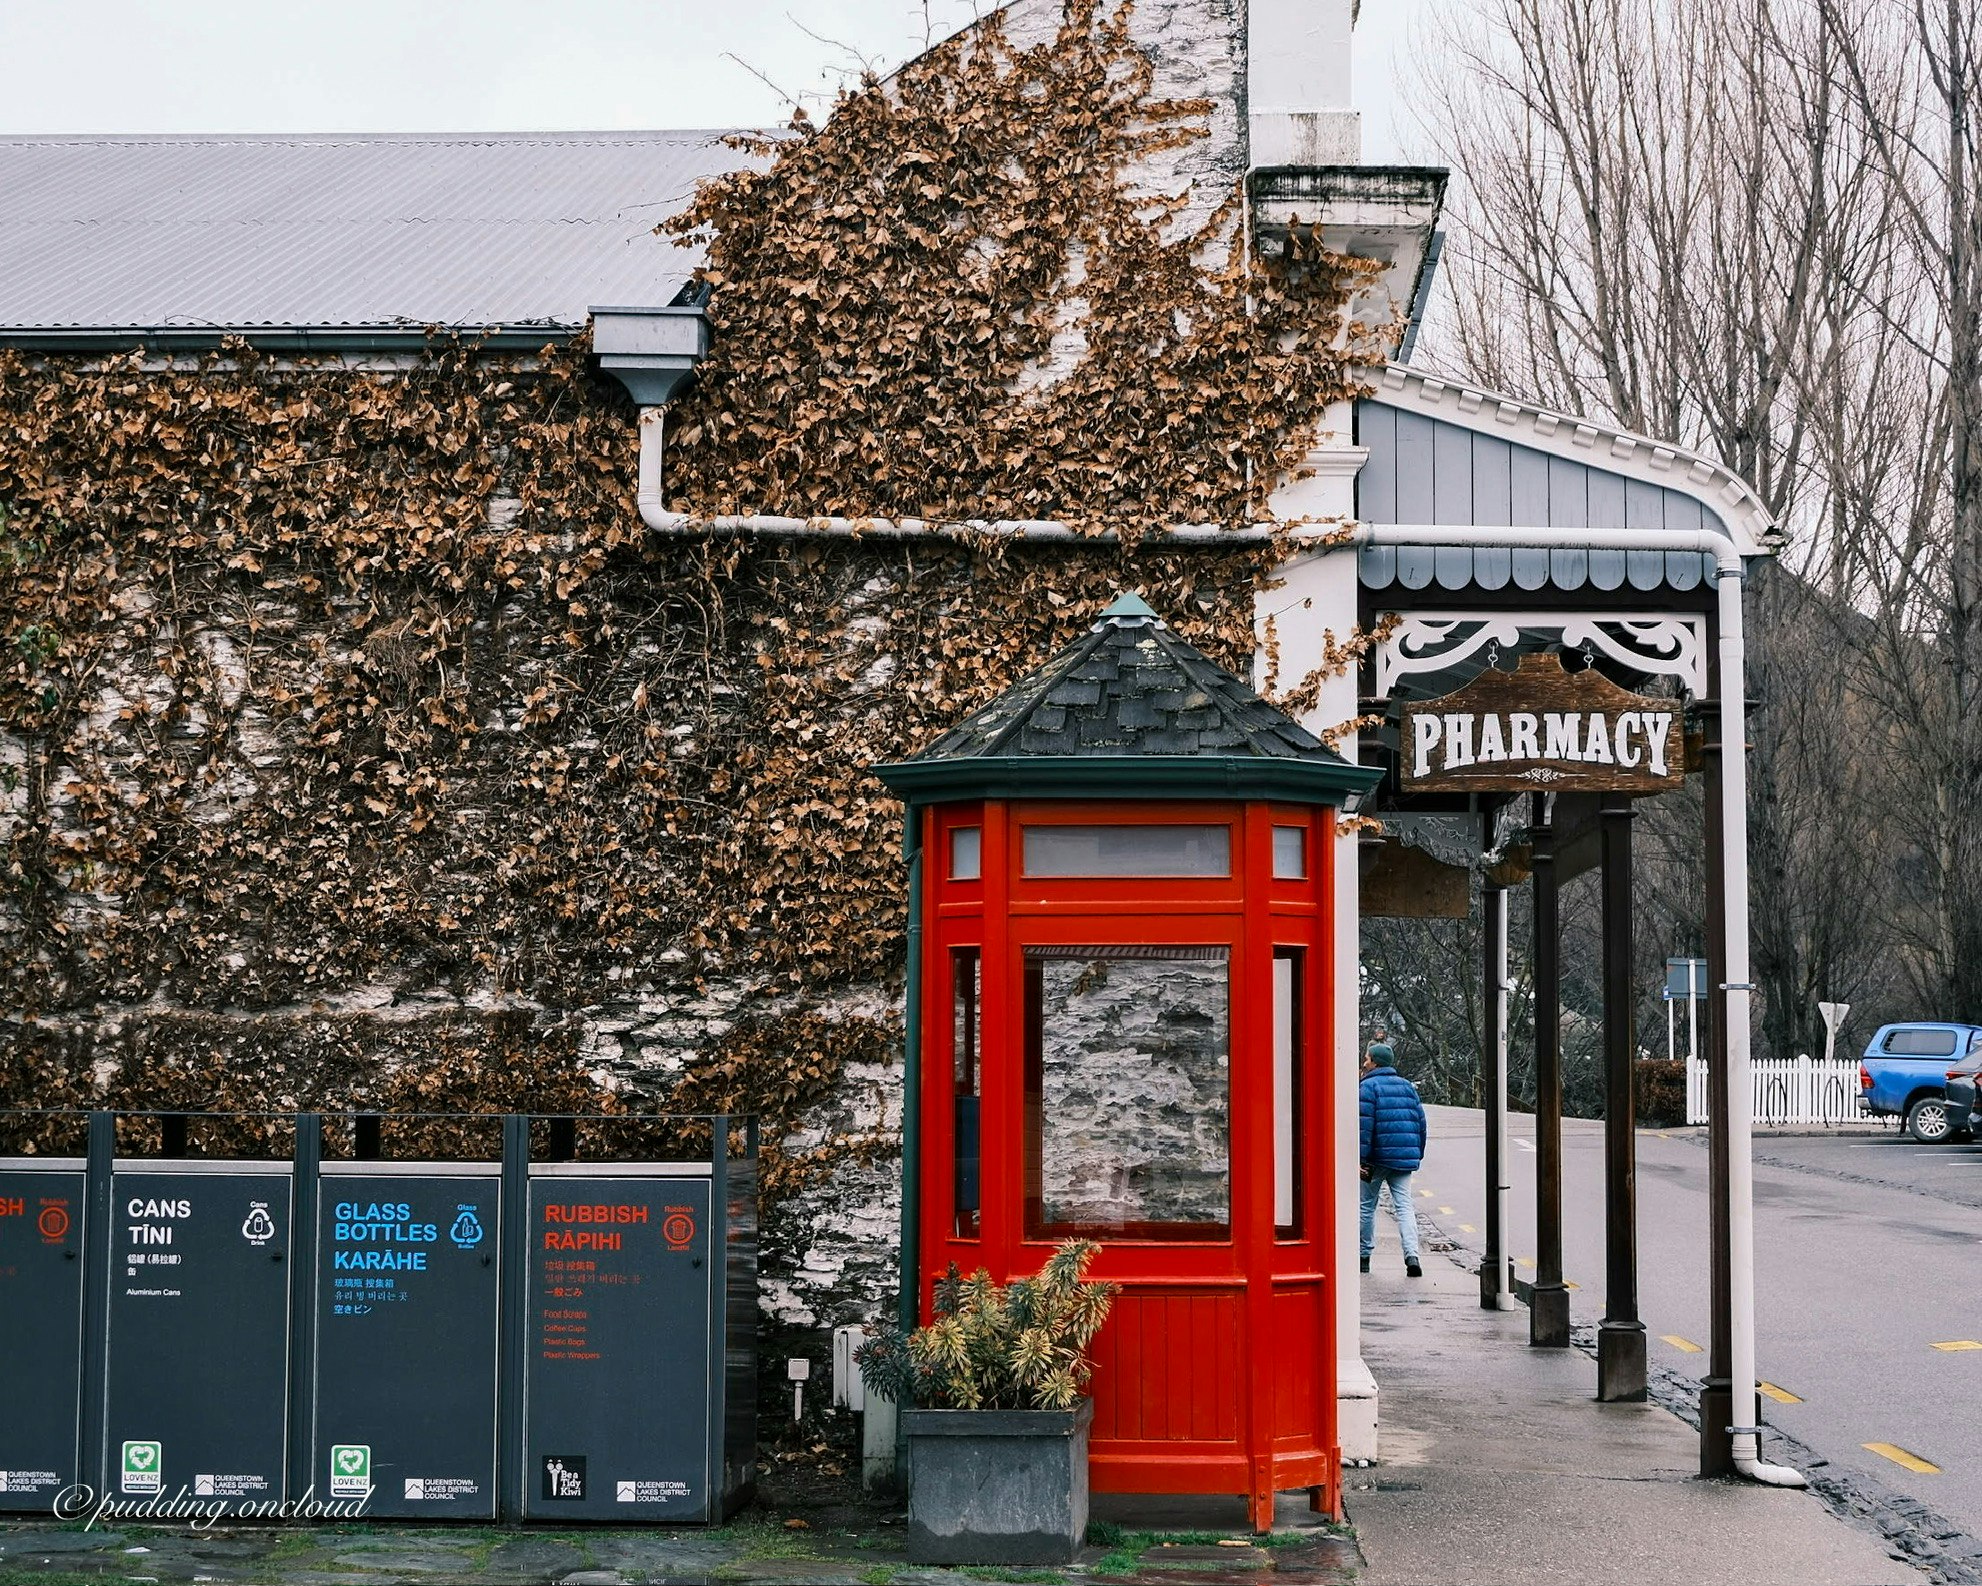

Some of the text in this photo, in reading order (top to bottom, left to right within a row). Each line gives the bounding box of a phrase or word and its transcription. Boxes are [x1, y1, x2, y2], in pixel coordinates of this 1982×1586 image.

[1412, 711, 1672, 778] PHARMACY
[127, 1198, 192, 1218] CANS
[335, 1202, 411, 1221] GLASS
[544, 1204, 648, 1224] RUBBISH
[128, 1223, 172, 1245] TĪNI
[335, 1222, 437, 1242] BOTTLES
[544, 1229, 621, 1250] RĀPIHI
[335, 1249, 427, 1270] KARĀHE
[126, 1288, 181, 1296] Aluminium Cans
[8, 1471, 56, 1479] QUEENSTOWN
[124, 1474, 159, 1482] LOVE NZ
[561, 1470, 572, 1479] Be
[8, 1478, 61, 1486] LAKES DISTRICT
[214, 1475, 262, 1483] QUEENSTOWN
[333, 1478, 368, 1486] LOVE NZ
[424, 1479, 472, 1487] QUEENSTOWN
[561, 1478, 581, 1488] Tidy
[214, 1482, 267, 1490] LAKES DISTRICT
[636, 1481, 684, 1489] QUEENSTOWN
[424, 1486, 477, 1494] LAKES DISTRICT
[561, 1486, 581, 1497] Kiwi
[636, 1488, 690, 1496] LAKES DISTRICT
